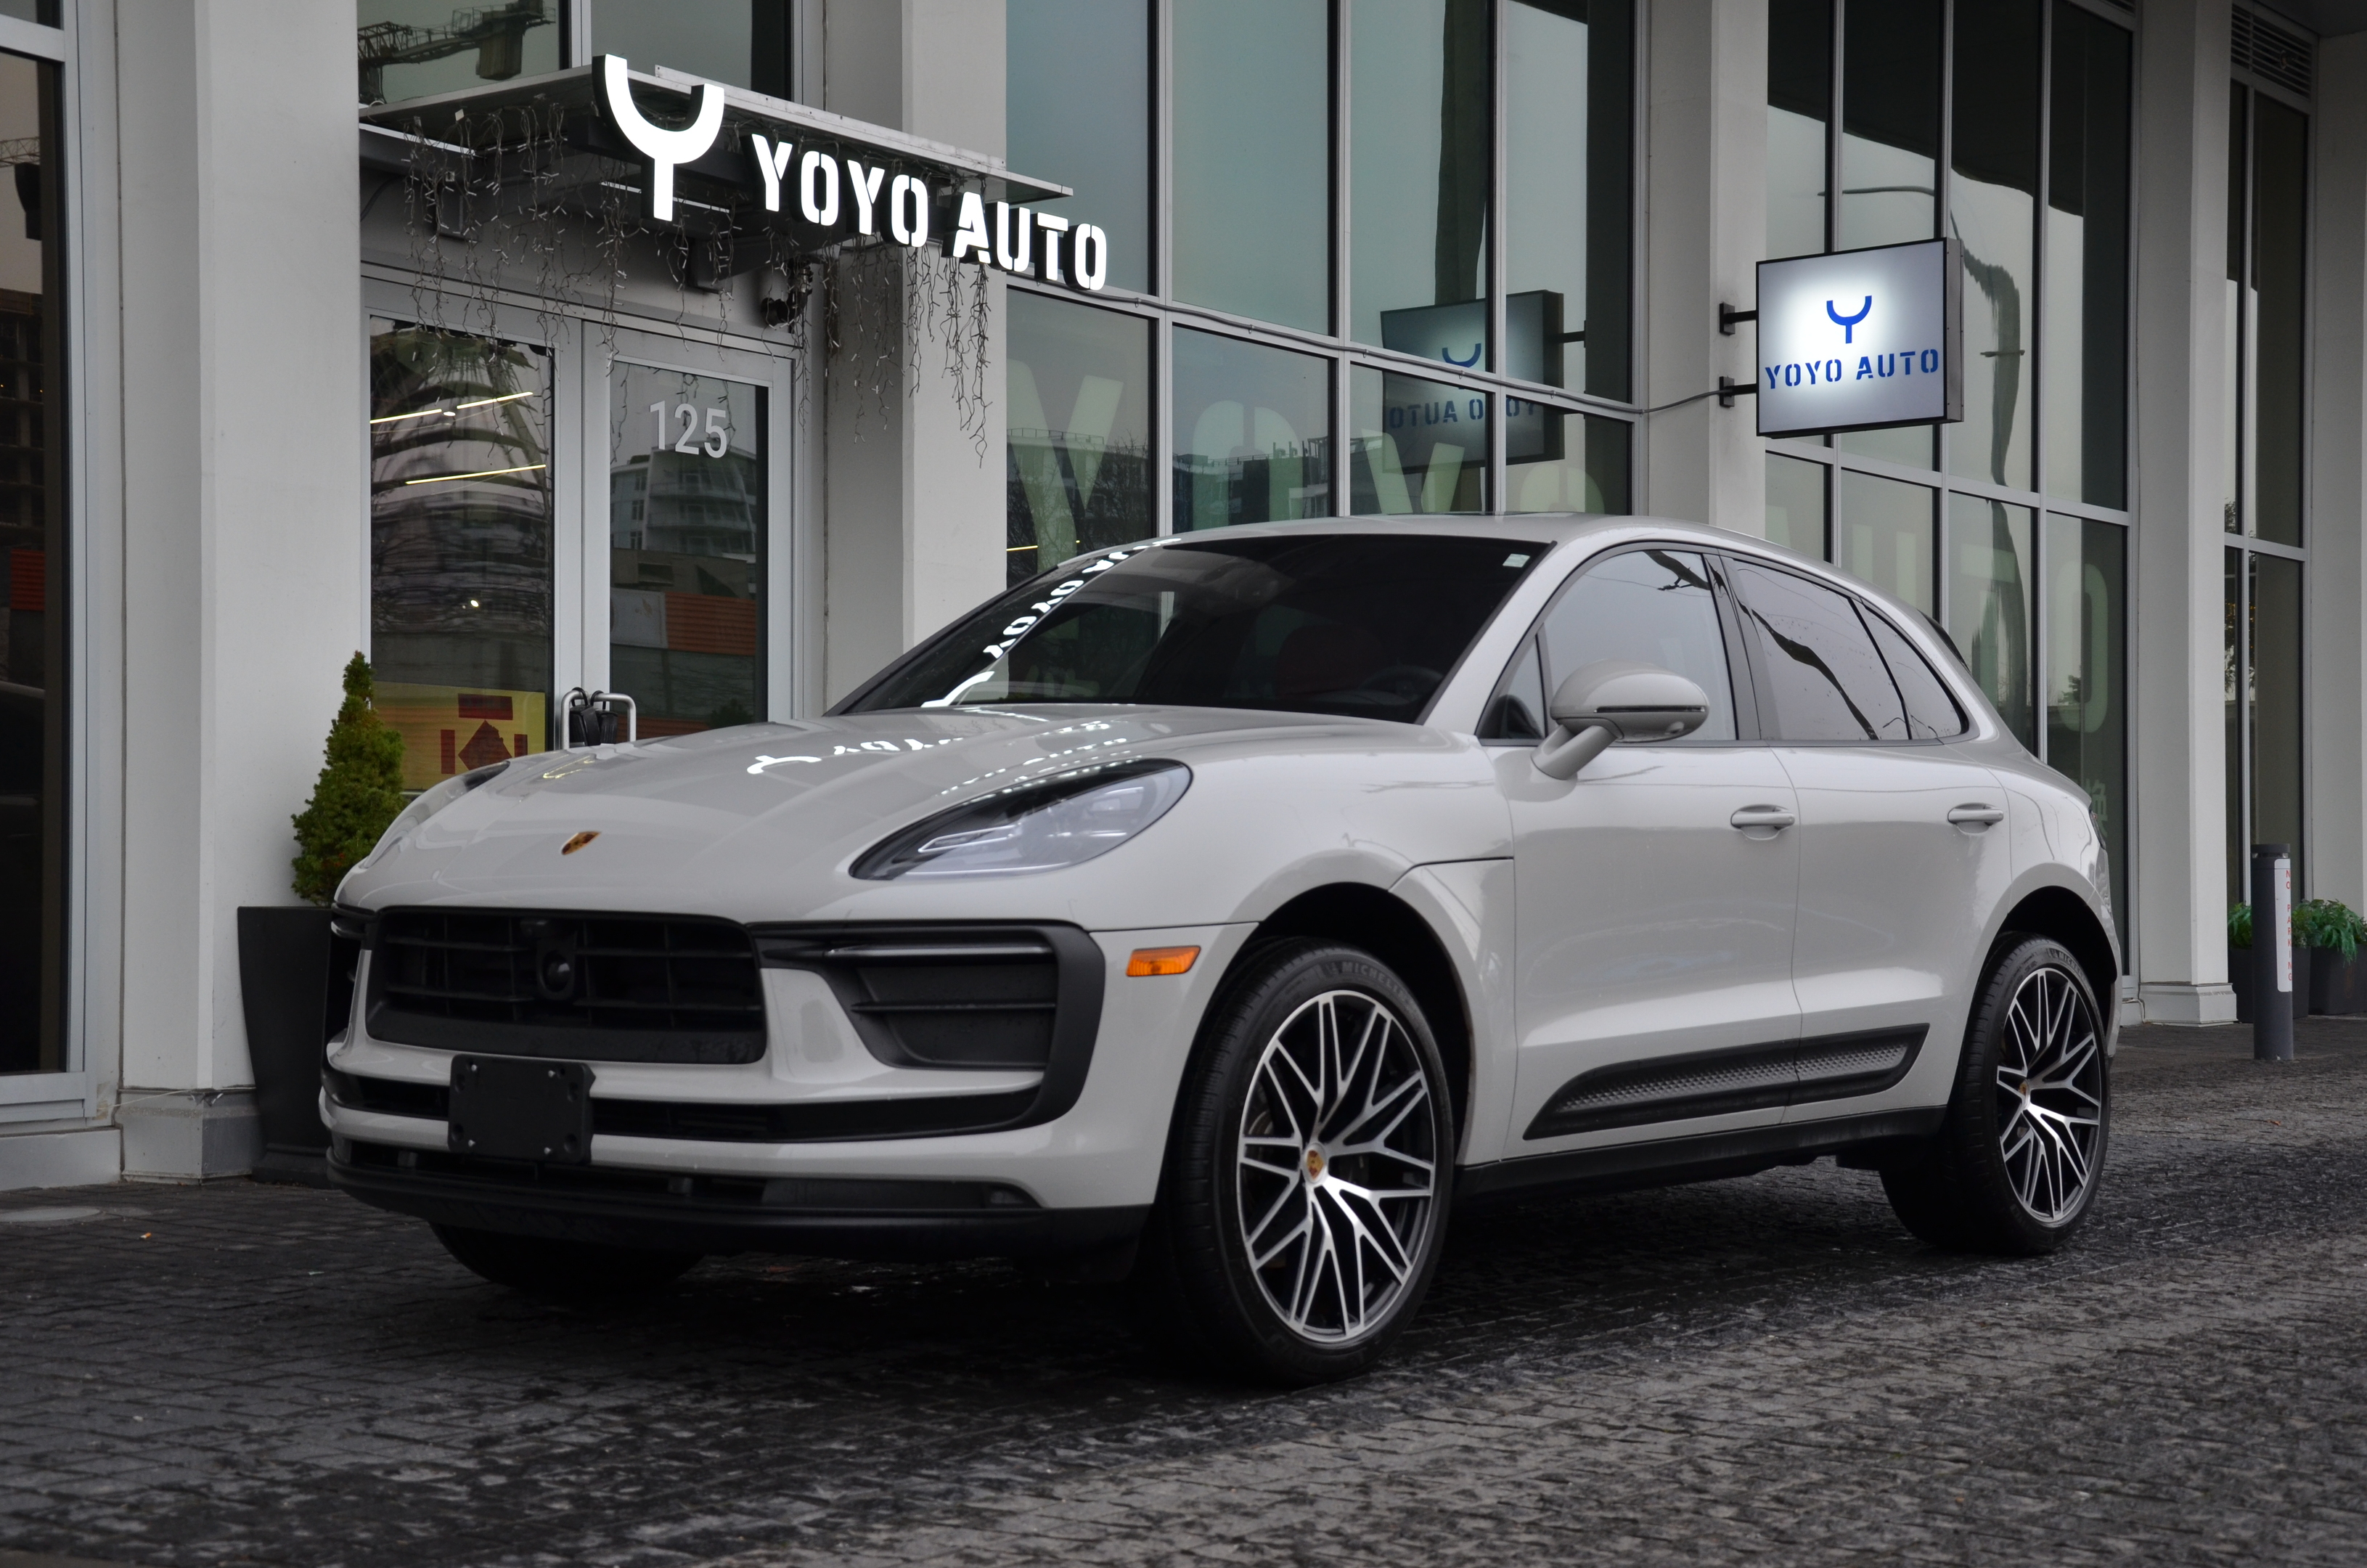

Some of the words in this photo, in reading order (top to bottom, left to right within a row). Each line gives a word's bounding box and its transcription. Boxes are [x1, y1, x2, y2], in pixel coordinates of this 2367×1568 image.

[751, 134, 929, 248] YOYO
[953, 191, 1108, 290] AUTO
[1765, 359, 1842, 389] YOYO
[1856, 348, 1939, 380] AUTO
[650, 400, 729, 459] 125
